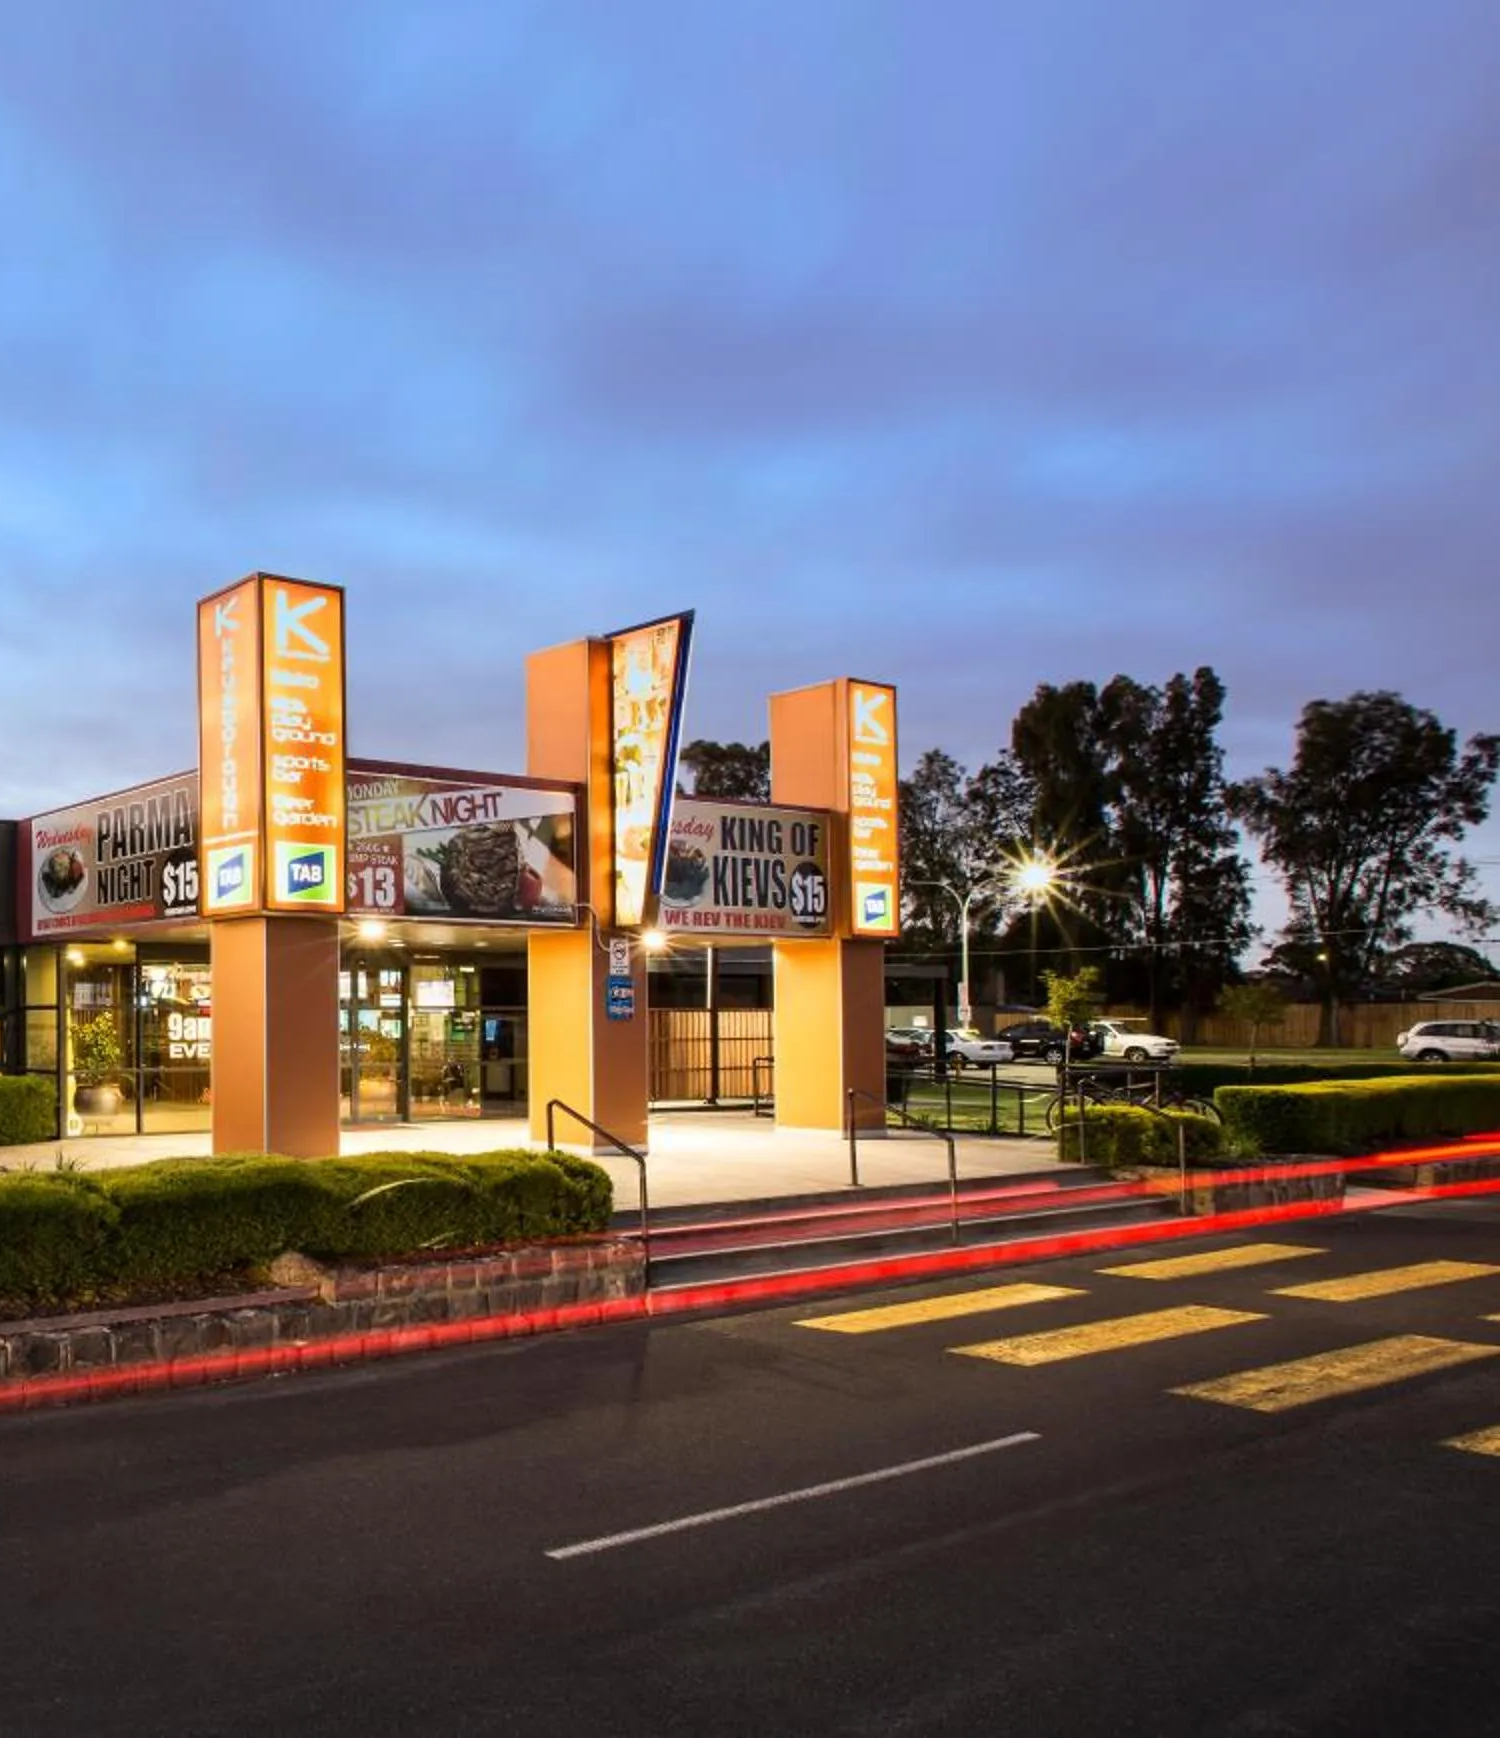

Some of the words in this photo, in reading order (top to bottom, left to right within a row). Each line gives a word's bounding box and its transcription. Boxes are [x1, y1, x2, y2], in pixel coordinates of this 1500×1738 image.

[96, 789, 194, 865] PARMA
[349, 793, 429, 836] STEAK
[430, 792, 503, 825] NIGHT
[671, 815, 715, 842] sday
[720, 815, 783, 854] KING
[790, 821, 820, 856] OF
[97, 859, 156, 905] NIGHT
[163, 860, 198, 906] $15
[291, 863, 323, 883] TAB
[712, 855, 787, 909] KIEVS
[791, 871, 826, 916] $15
[665, 910, 690, 926] WE
[693, 911, 721, 927] REV
[724, 913, 750, 929] THE
[169, 1043, 211, 1059] EVE
